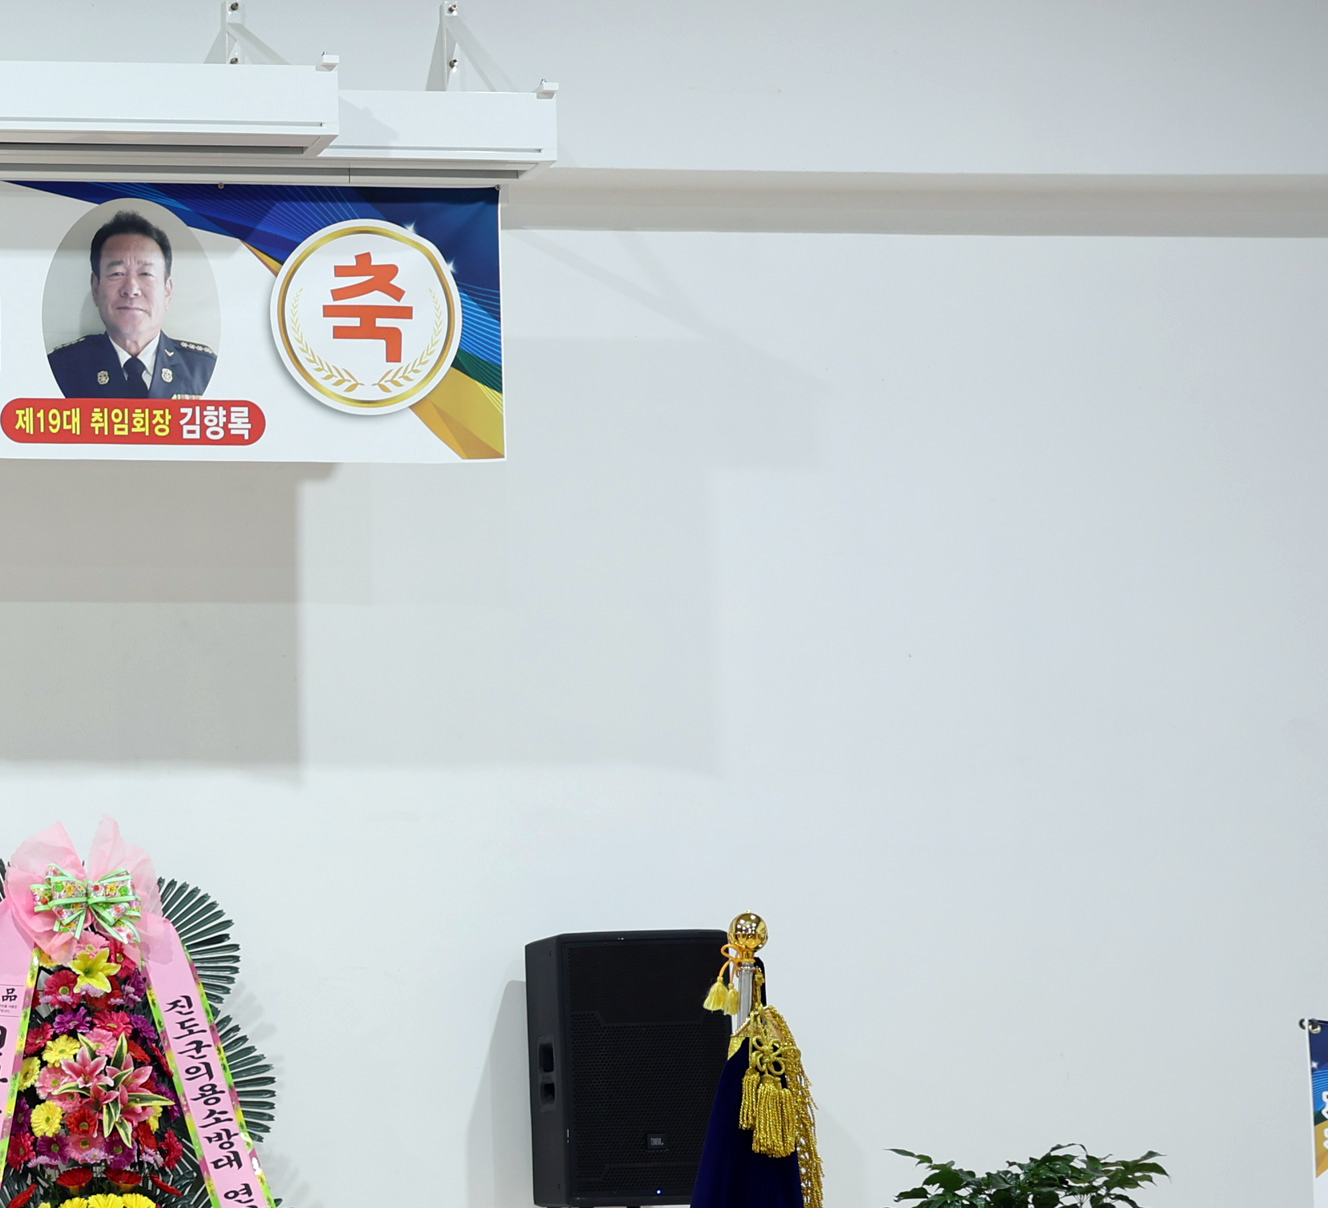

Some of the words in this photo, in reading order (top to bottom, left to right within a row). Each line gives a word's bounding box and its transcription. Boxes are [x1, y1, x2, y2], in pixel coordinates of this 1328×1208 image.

[322, 252, 413, 363] 축
[14, 406, 82, 436] 제19대
[90, 406, 172, 437] 취임회장
[179, 405, 252, 440] 김향록
[164, 994, 243, 1172] 진도군의용소방대
